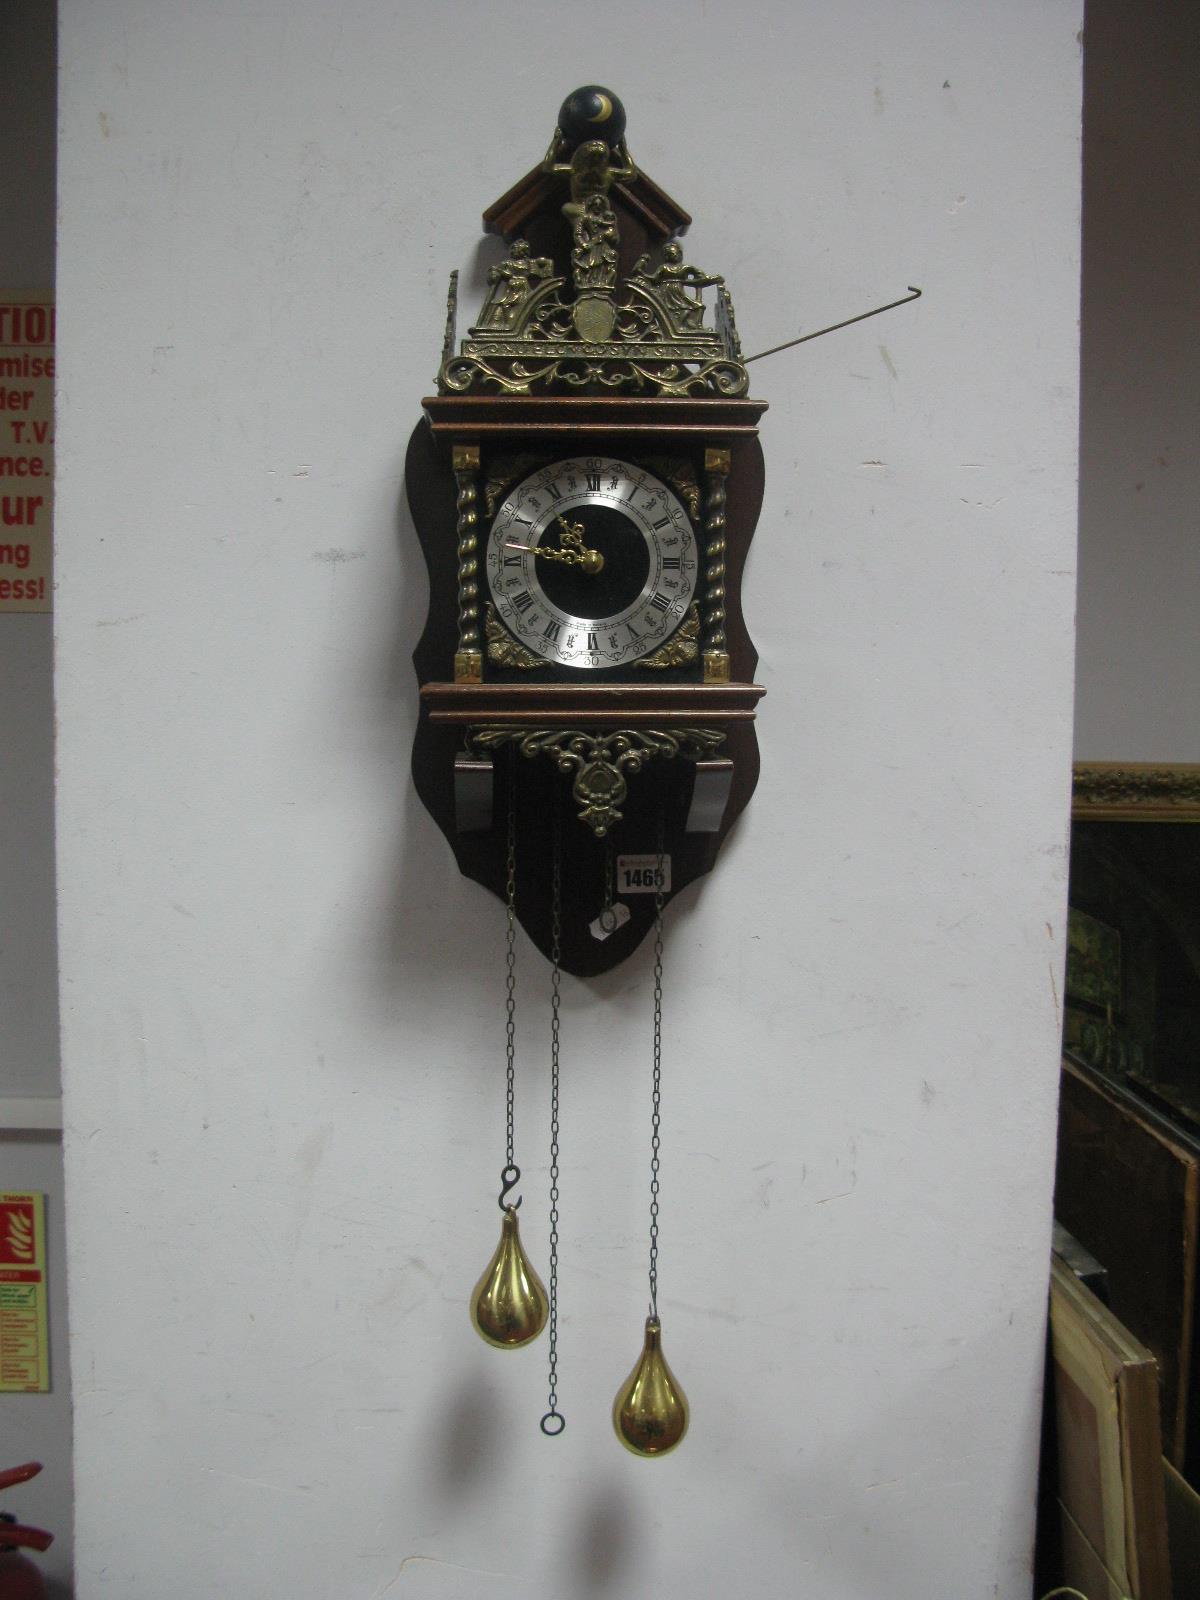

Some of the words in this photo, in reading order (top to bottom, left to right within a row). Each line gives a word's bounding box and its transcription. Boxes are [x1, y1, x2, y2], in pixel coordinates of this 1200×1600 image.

[585, 473, 601, 491] XII
[544, 482, 562, 502] XI
[514, 514, 534, 529] X
[652, 515, 671, 532] II
[503, 555, 521, 567] IX
[662, 557, 681, 570] III
[587, 632, 599, 650] VI
